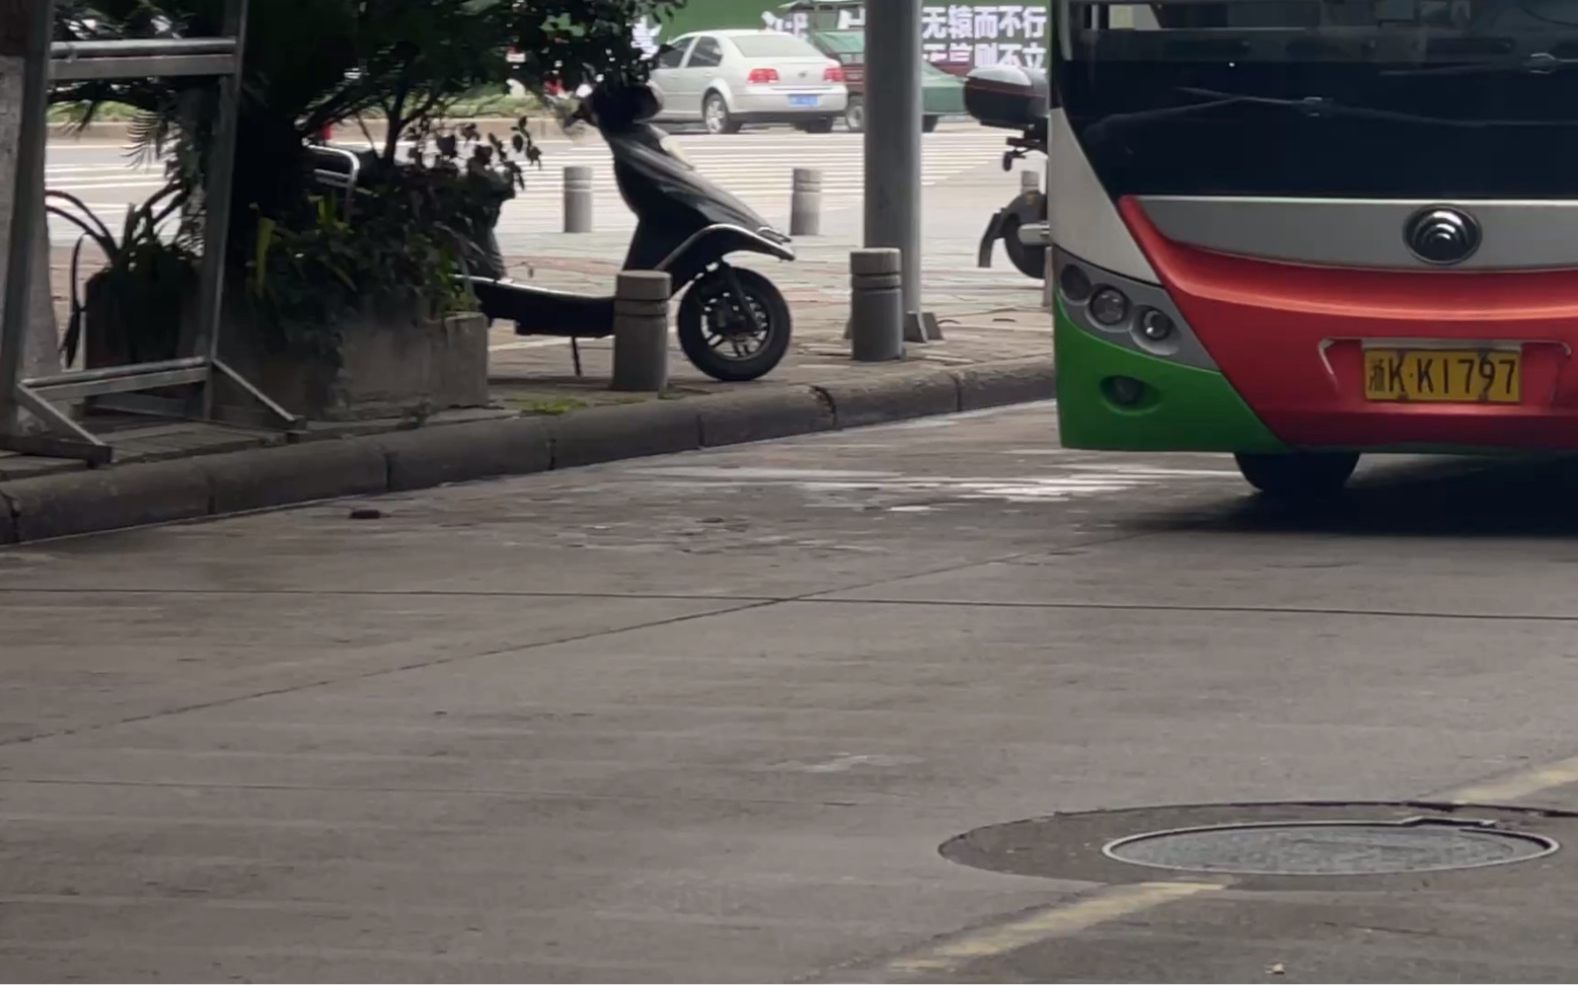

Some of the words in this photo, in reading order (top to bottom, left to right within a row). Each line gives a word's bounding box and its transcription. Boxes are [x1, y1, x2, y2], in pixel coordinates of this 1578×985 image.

[921, 5, 1047, 39] 无辕而不行
